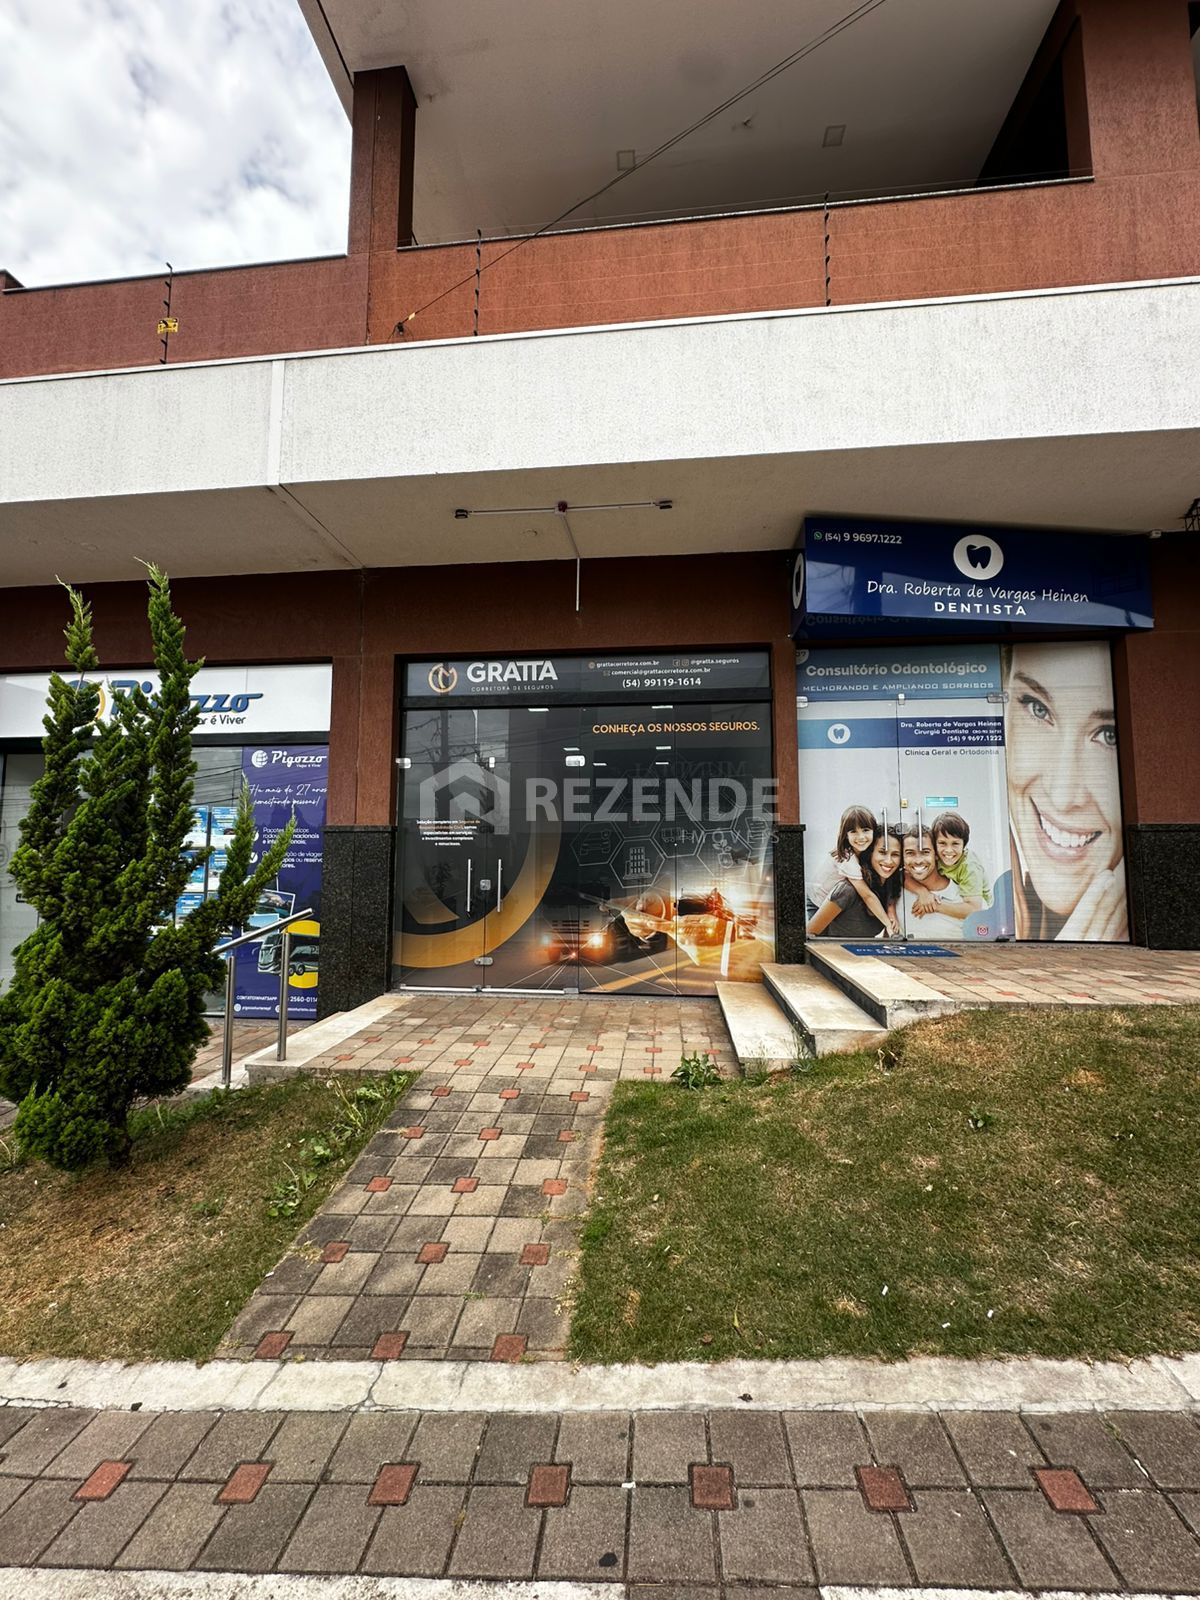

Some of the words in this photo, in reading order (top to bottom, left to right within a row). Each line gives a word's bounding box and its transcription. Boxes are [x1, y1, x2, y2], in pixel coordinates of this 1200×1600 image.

[825, 532, 841, 542] (54)
[843, 532, 850, 542] 9
[852, 532, 902, 544] 9697.1222
[867, 580, 898, 594] Dra.
[904, 582, 961, 598] Roberta
[967, 587, 984, 598] de
[989, 586, 1036, 604] Vargas
[1042, 588, 1089, 603] Heinen
[934, 601, 1027, 616] DENTISTA
[467, 660, 558, 682] GRATTA
[596, 660, 660, 669] grattacorretora.com.br
[806, 663, 888, 677] Consultório
[891, 662, 987, 677] Odontológico
[611, 667, 711, 676] comercial@grattacorretora.com.br
[622, 678, 641, 688] (54)
[644, 677, 701, 687] 99119-1614
[220, 714, 246, 725] Viver
[592, 723, 645, 736] CONHEÇA
[648, 723, 662, 733] OS
[664, 722, 707, 732] NOSSOS
[709, 721, 760, 731] SEGUROS.
[959, 748, 999, 756] Ortodontia
[271, 750, 327, 768] Pigozzo
[296, 783, 311, 796] 27
